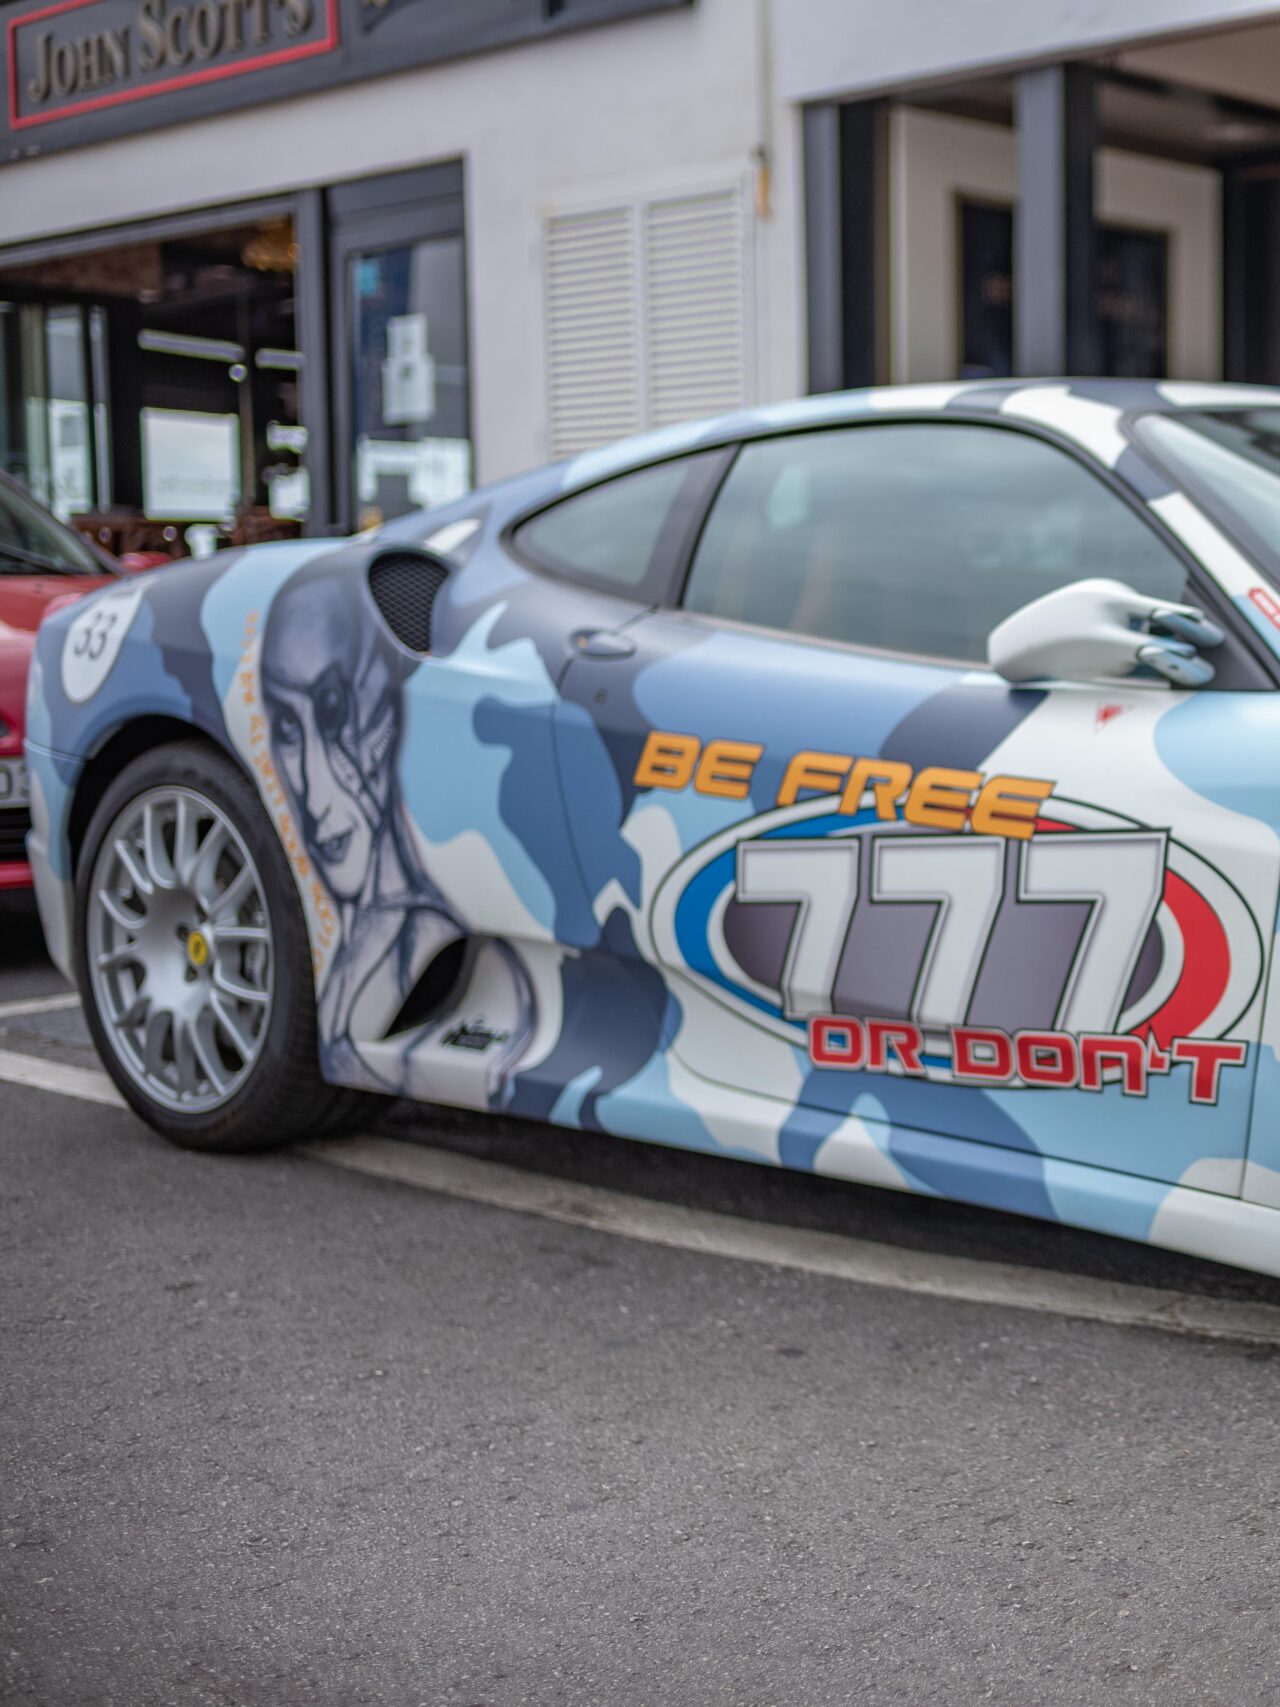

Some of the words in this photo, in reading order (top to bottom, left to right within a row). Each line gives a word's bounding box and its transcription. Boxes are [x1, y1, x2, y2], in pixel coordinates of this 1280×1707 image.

[28, 25, 131, 103] JOHN
[633, 730, 764, 799] BE
[776, 750, 1057, 840] FREE
[735, 827, 1171, 1036] 777
[806, 1011, 927, 1077] OR
